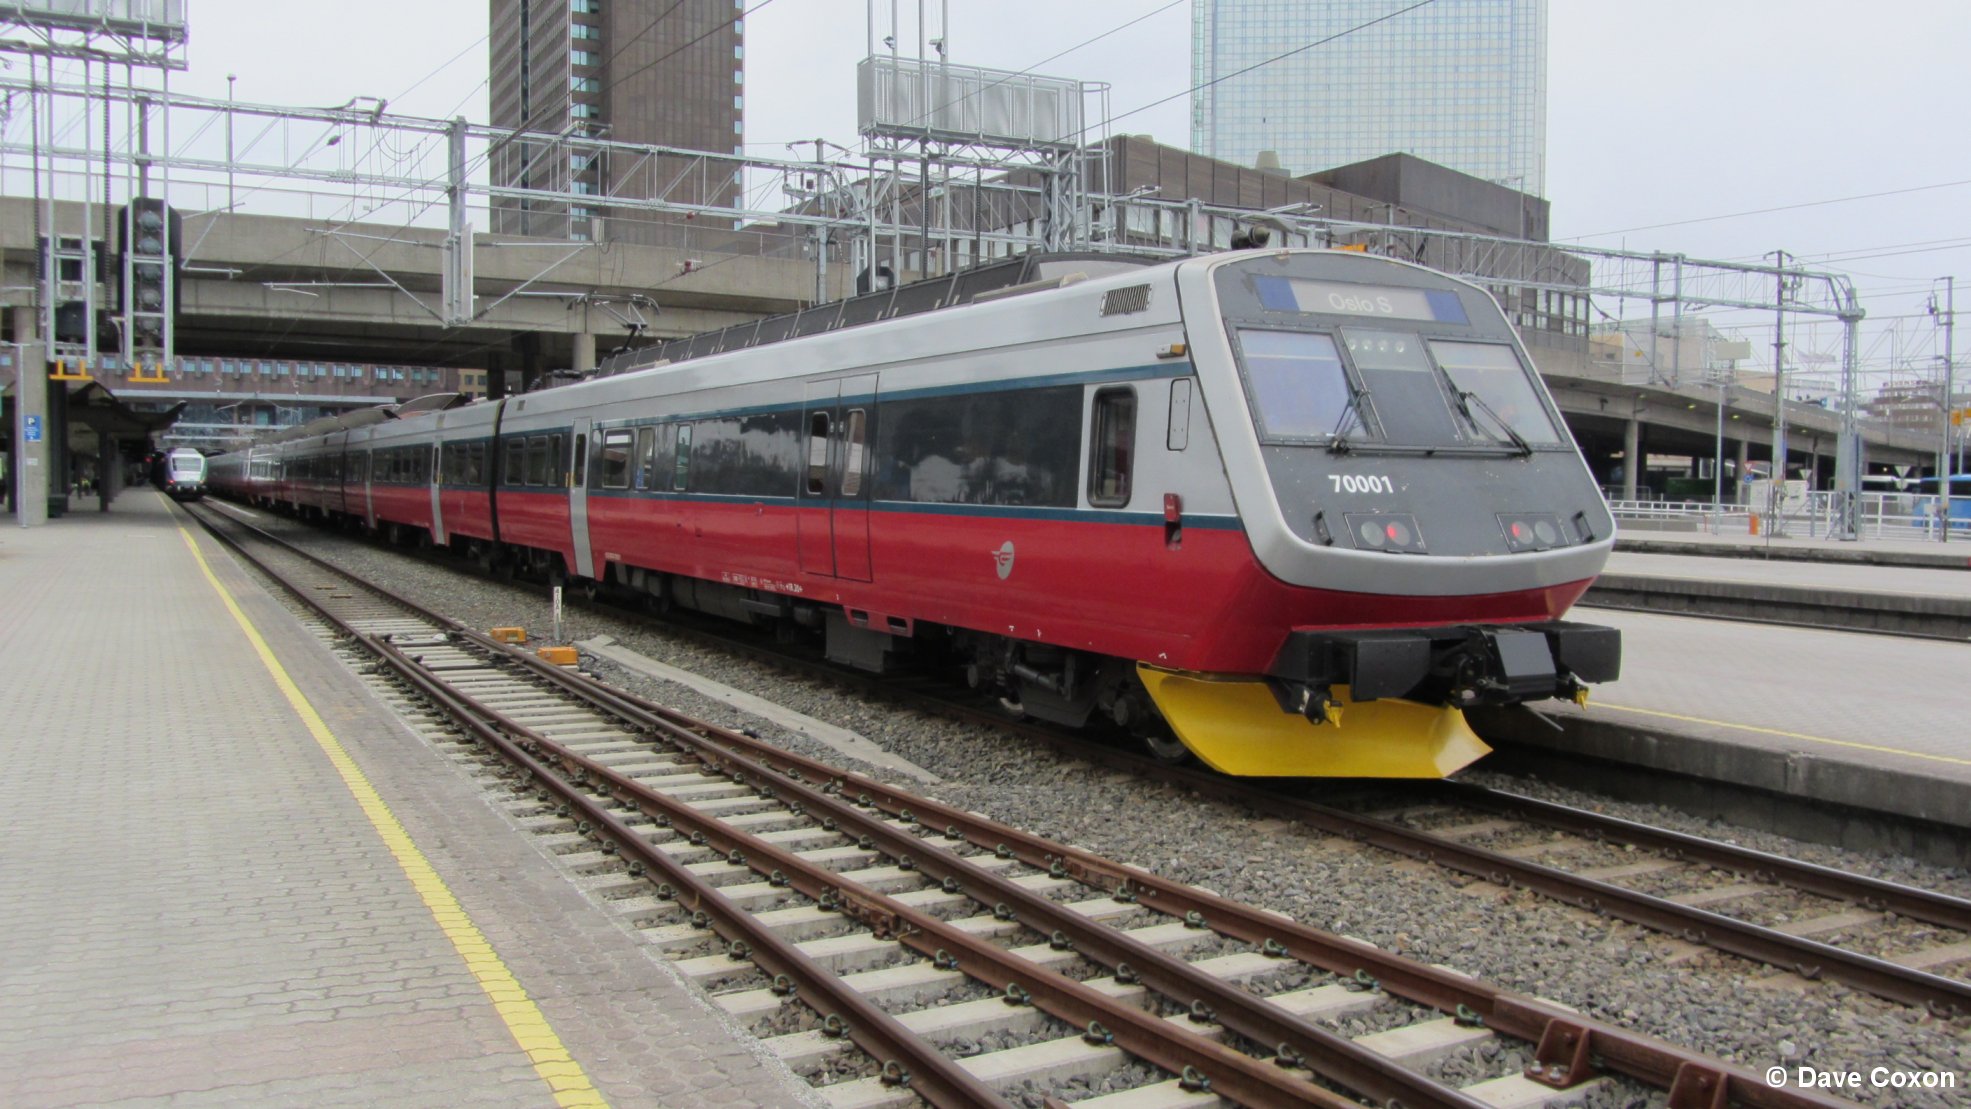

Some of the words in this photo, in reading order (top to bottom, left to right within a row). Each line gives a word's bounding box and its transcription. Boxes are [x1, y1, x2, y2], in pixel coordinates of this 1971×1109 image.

[1328, 292, 1374, 312] Oslo
[1376, 296, 1393, 313] S
[28, 417, 36, 425] P
[1328, 474, 1394, 494] 70001
